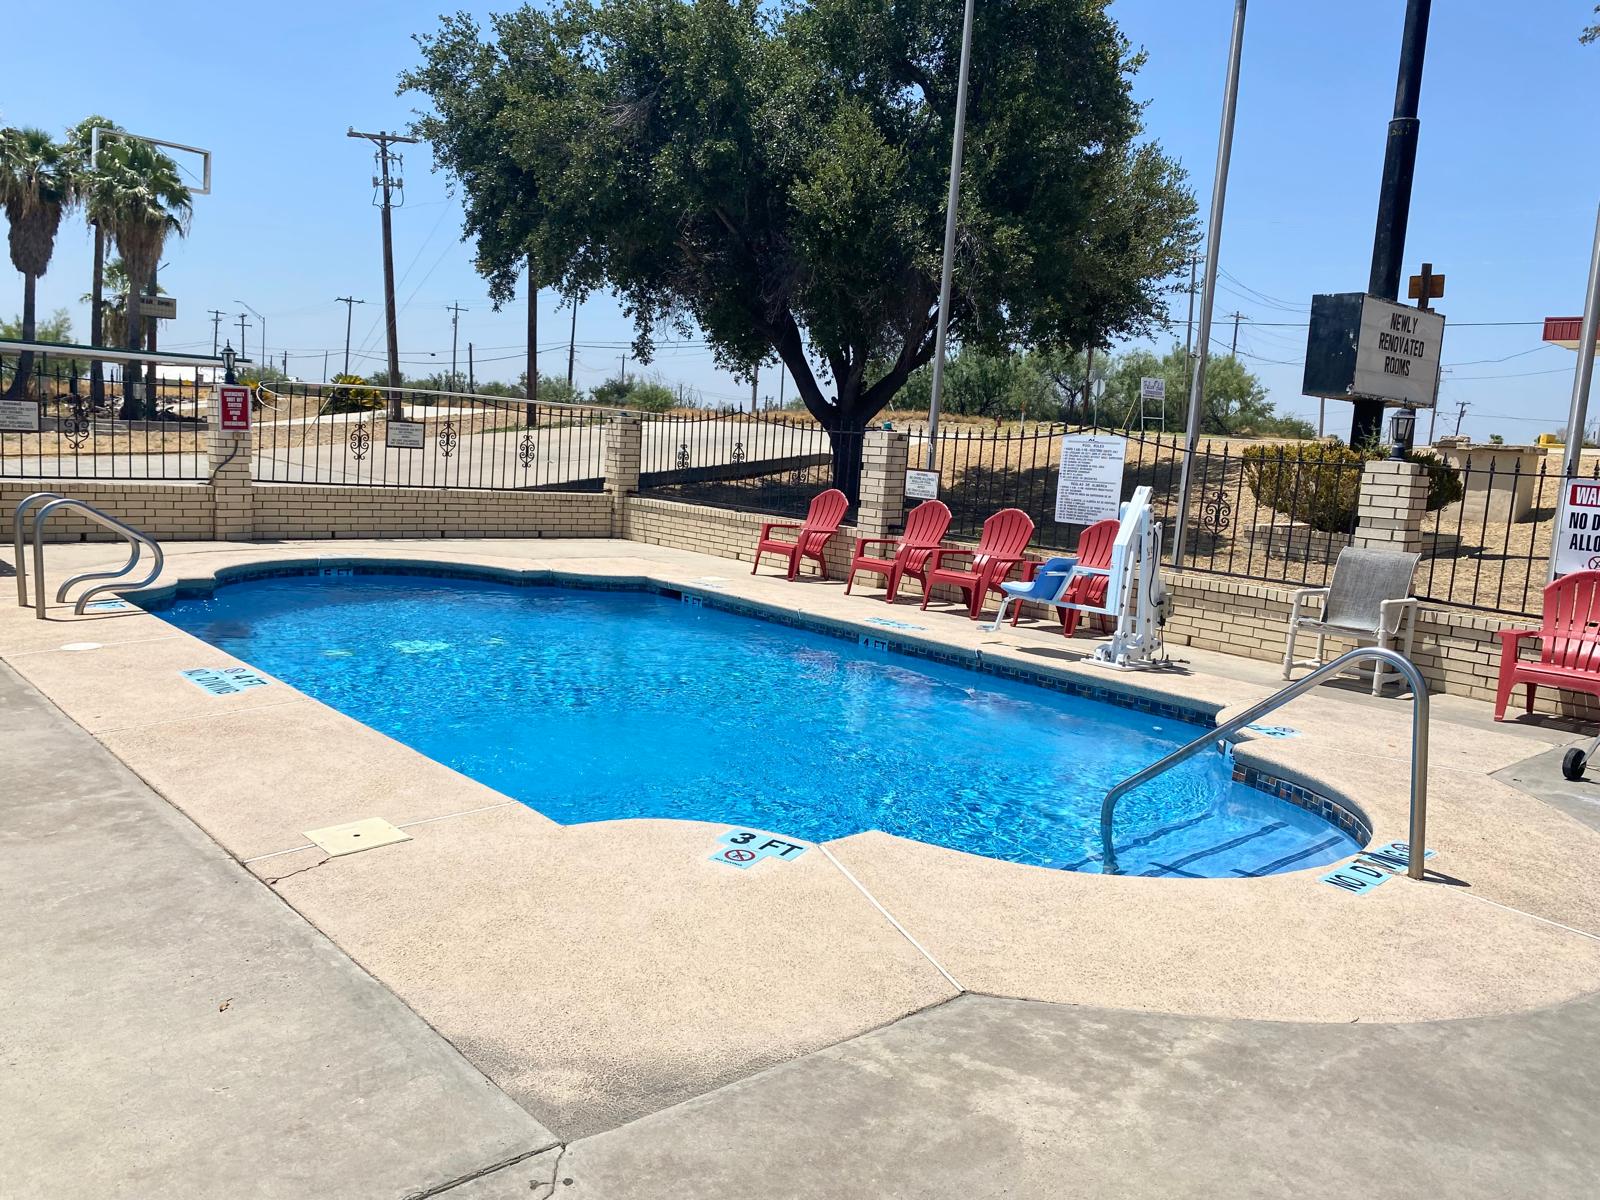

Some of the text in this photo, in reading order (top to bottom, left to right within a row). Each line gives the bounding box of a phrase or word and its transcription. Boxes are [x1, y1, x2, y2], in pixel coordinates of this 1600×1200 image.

[1390, 313, 1418, 334] NEWLY
[1379, 332, 1424, 357] RENOVATED
[1384, 356, 1410, 376] ROOMS
[1569, 512, 1587, 530] NO
[874, 640, 886, 650] FT
[730, 833, 804, 856] 3 FT
[1325, 874, 1367, 892] NO
